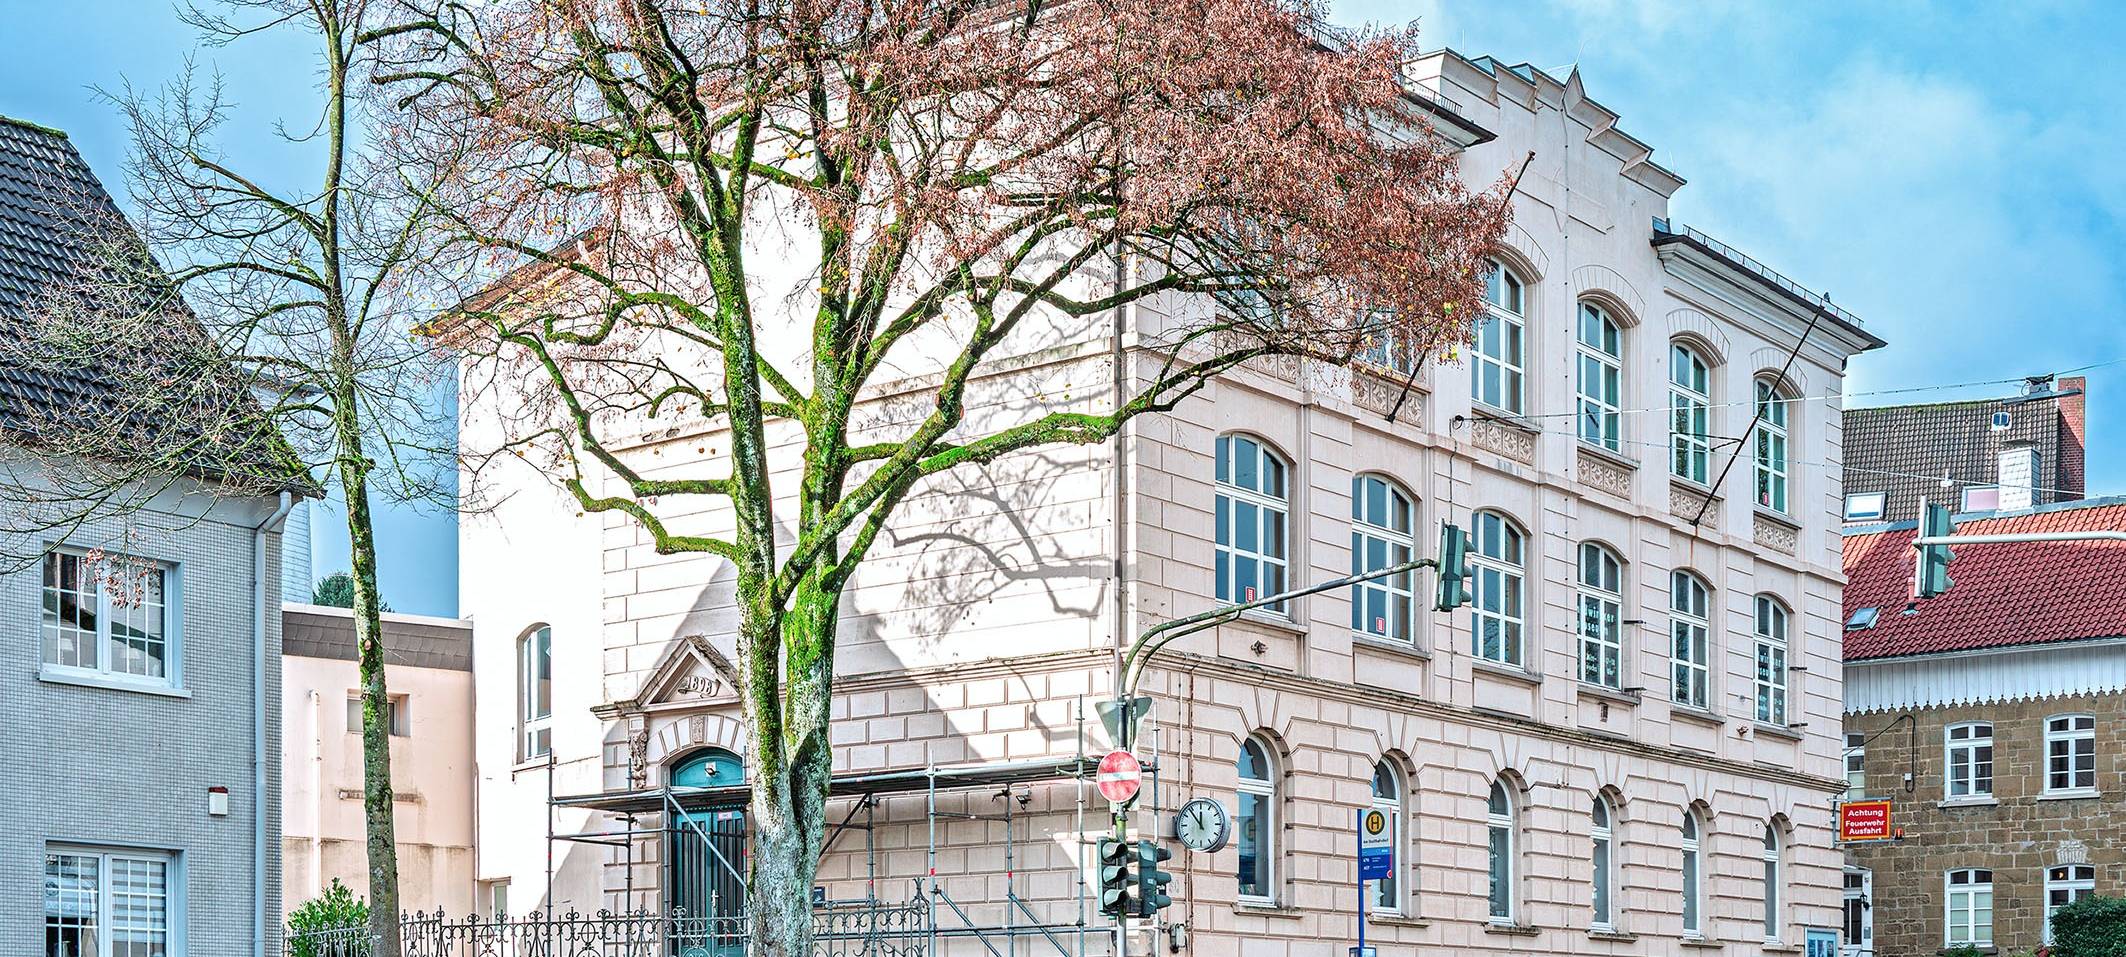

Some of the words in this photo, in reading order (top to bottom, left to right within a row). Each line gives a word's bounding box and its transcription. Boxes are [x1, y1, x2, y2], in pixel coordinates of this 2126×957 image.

[687, 675, 712, 694] 1898
[1848, 809, 1883, 817] Achtung
[1371, 815, 1379, 830] H
[1845, 819, 1885, 827] Feuerwehr
[1849, 827, 1882, 835] Ausfahrt
